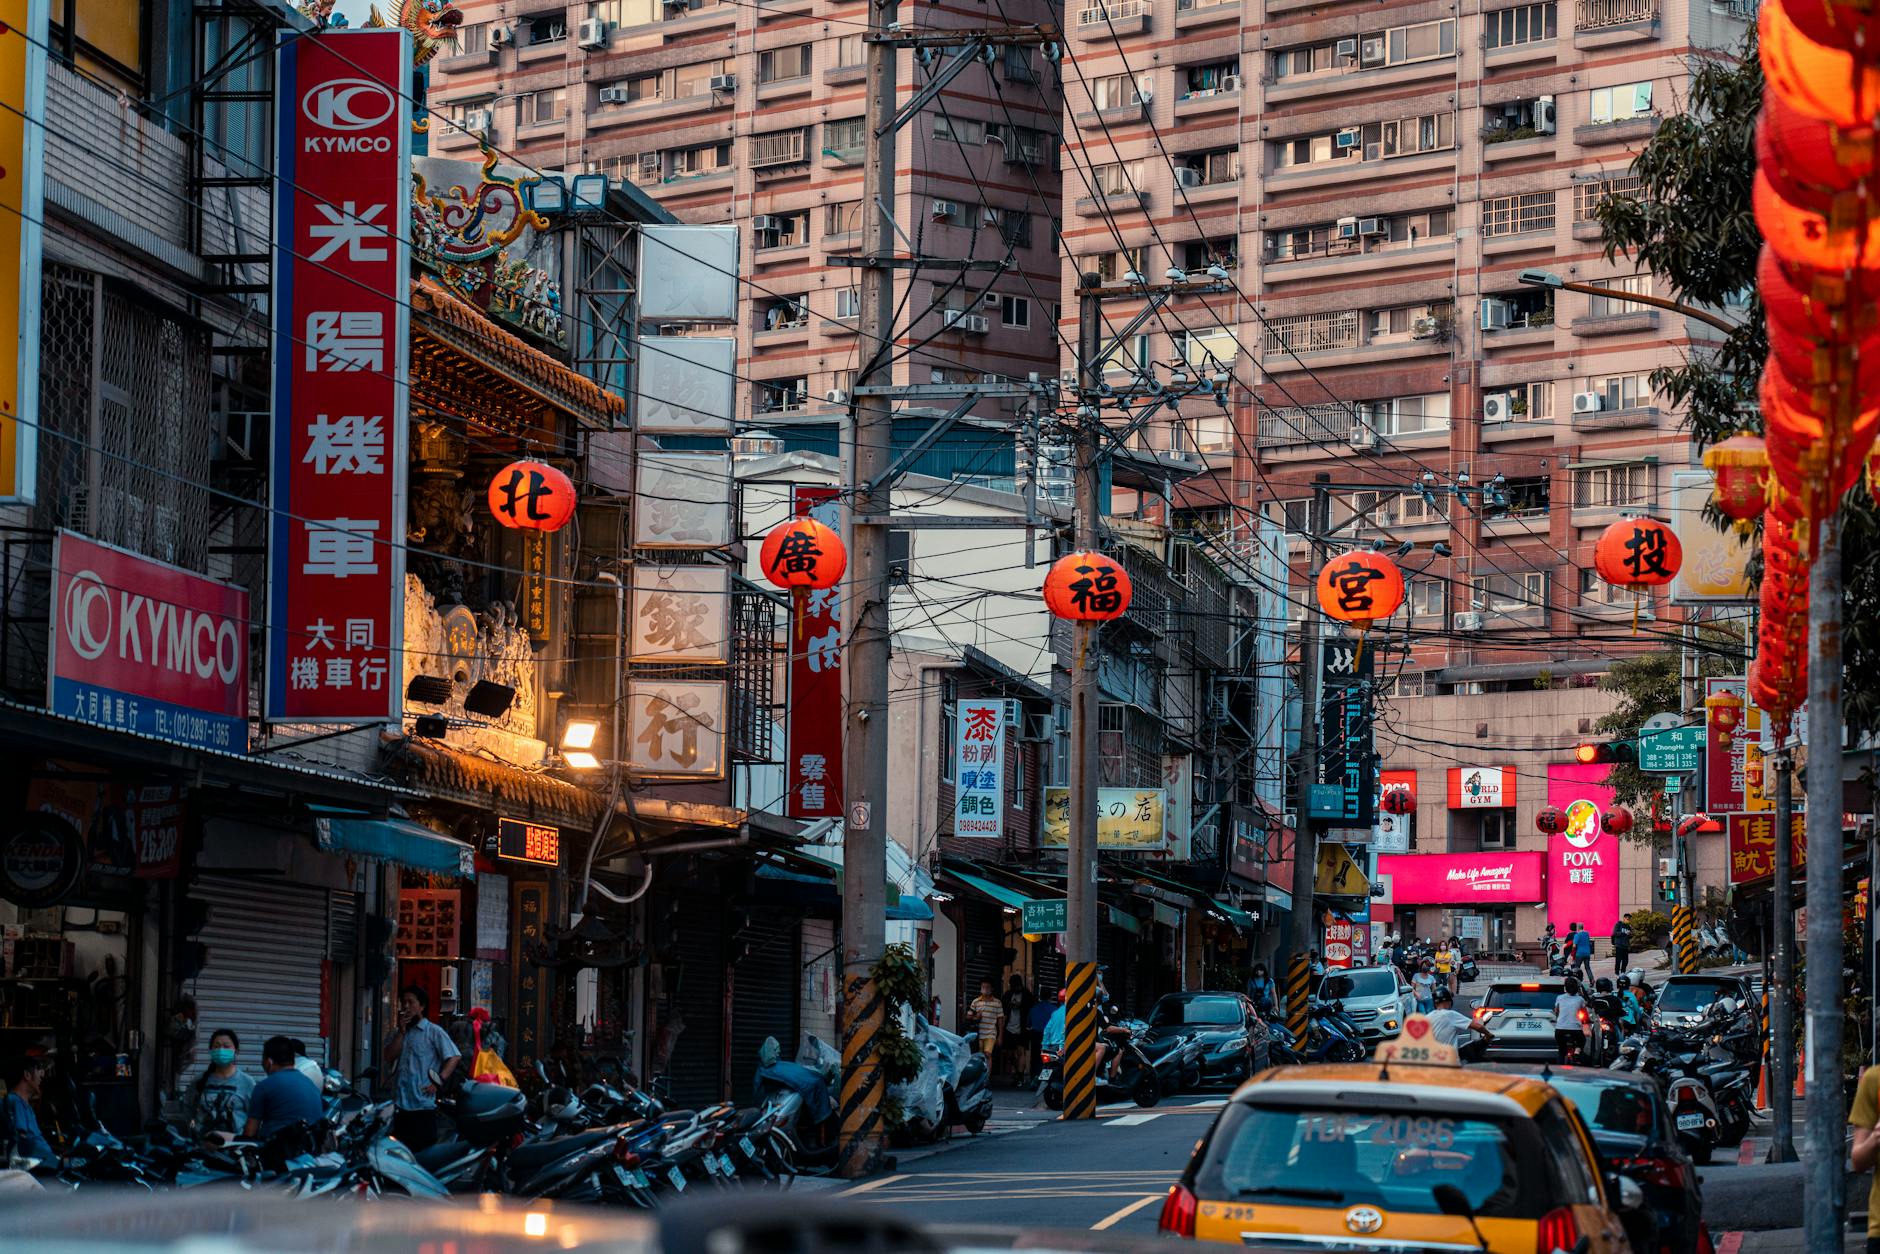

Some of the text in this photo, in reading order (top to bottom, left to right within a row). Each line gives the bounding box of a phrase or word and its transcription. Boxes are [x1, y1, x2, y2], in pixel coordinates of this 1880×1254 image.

[305, 137, 391, 153] KYMCO
[303, 201, 389, 578] 光陽機車
[499, 470, 553, 520] 北
[770, 531, 823, 581] 廣
[1623, 527, 1672, 578] 投
[1069, 565, 1122, 613] 福
[1329, 562, 1385, 611] 宮
[119, 592, 239, 684] KYMCO
[306, 619, 374, 651] 大同
[291, 657, 388, 691] 機車行
[75, 690, 138, 729] 大同機車行
[964, 707, 996, 742] 漆
[1647, 731, 1706, 743] 中和街
[962, 744, 997, 764] 粉刷
[800, 754, 826, 810] 零售
[961, 770, 997, 790] 噴塗
[961, 795, 996, 816] 調色
[1389, 793, 1409, 811] 北
[1470, 796, 1491, 804] GYM
[1563, 851, 1603, 866] POYA
[1447, 864, 1513, 881] Make Life Amazing!
[1027, 903, 1064, 917] 杏林一路
[1401, 1047, 1430, 1060] 295
[1224, 1207, 1255, 1220] 295
